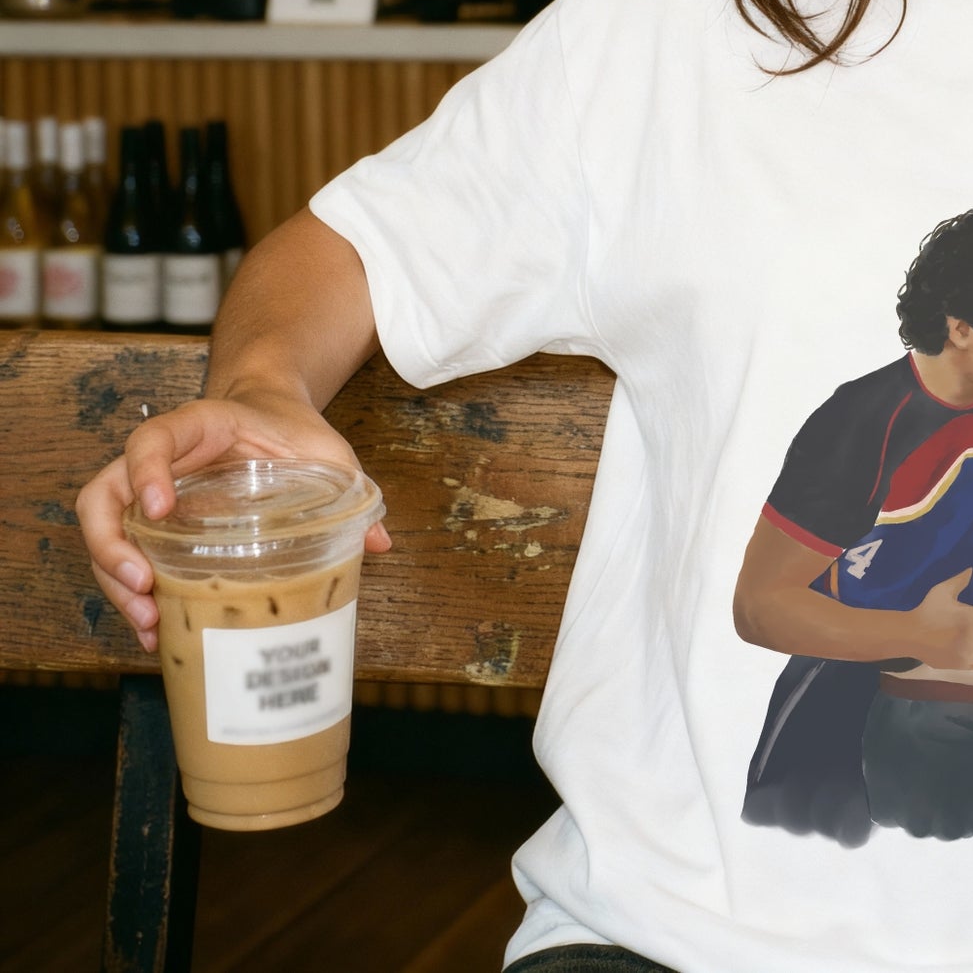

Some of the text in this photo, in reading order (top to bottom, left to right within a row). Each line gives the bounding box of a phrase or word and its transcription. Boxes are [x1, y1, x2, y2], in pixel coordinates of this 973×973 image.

[844, 539, 883, 580] 4
[258, 637, 321, 664] YOUR
[245, 658, 331, 690] DESIGN
[258, 682, 319, 711] HERE
